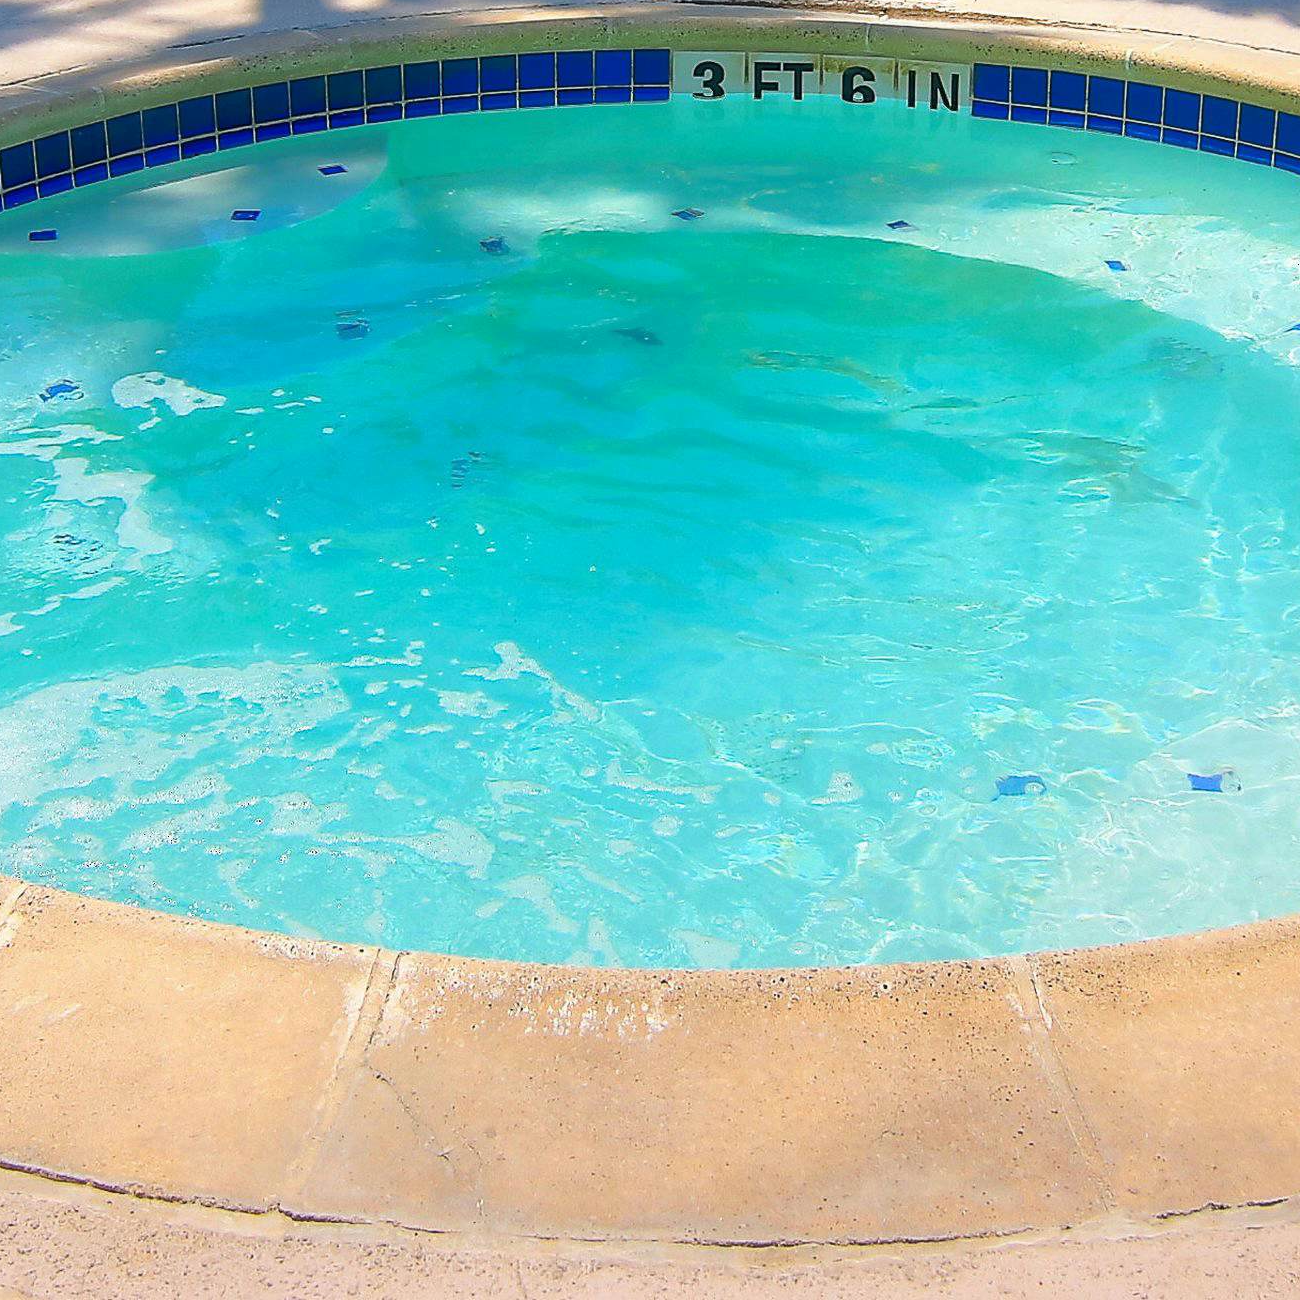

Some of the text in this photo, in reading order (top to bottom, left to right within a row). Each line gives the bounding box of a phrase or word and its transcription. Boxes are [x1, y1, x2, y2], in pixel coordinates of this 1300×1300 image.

[692, 61, 960, 112] 3 FT 6 IN
